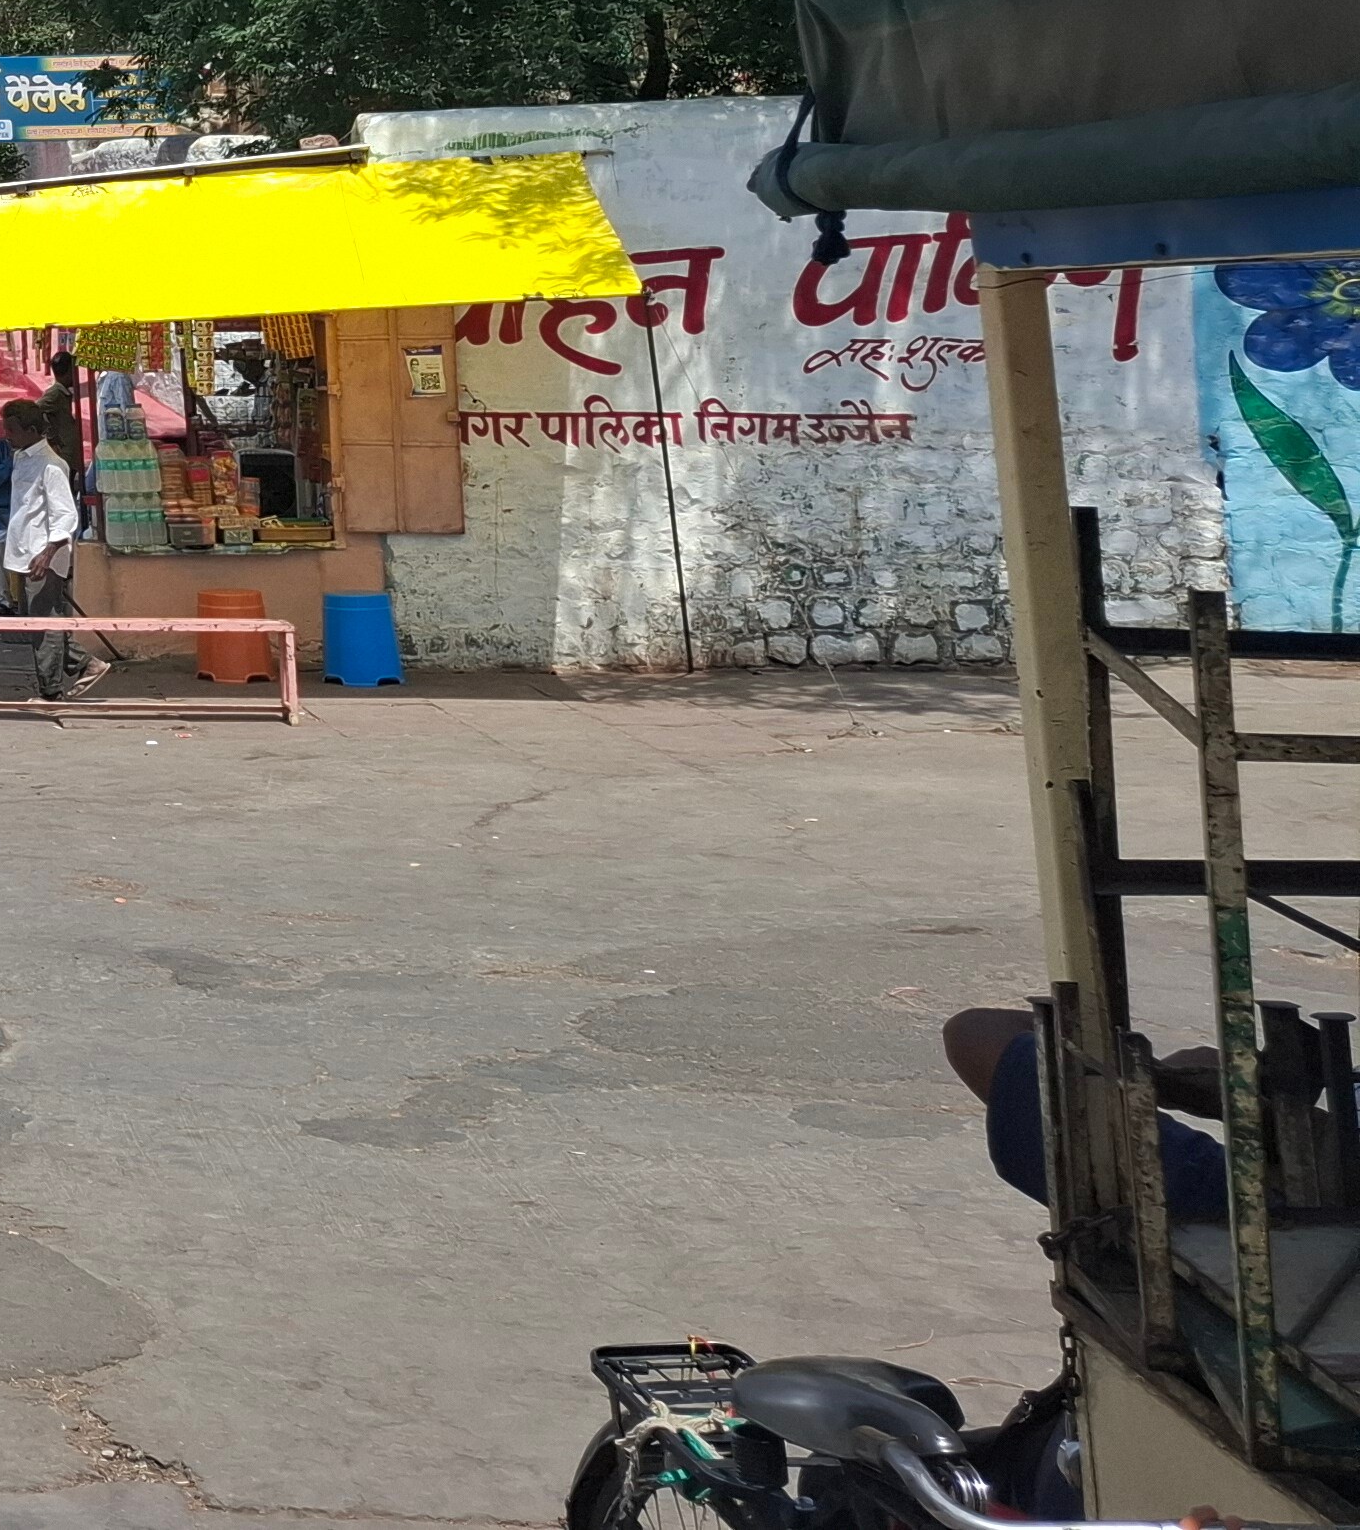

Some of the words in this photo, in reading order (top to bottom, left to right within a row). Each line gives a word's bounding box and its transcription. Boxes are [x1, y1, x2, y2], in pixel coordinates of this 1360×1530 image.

[5, 74, 88, 113] पैलेस
[535, 394, 684, 455] पालिका
[693, 396, 801, 448] निगम
[802, 399, 917, 446] उज्जैन
